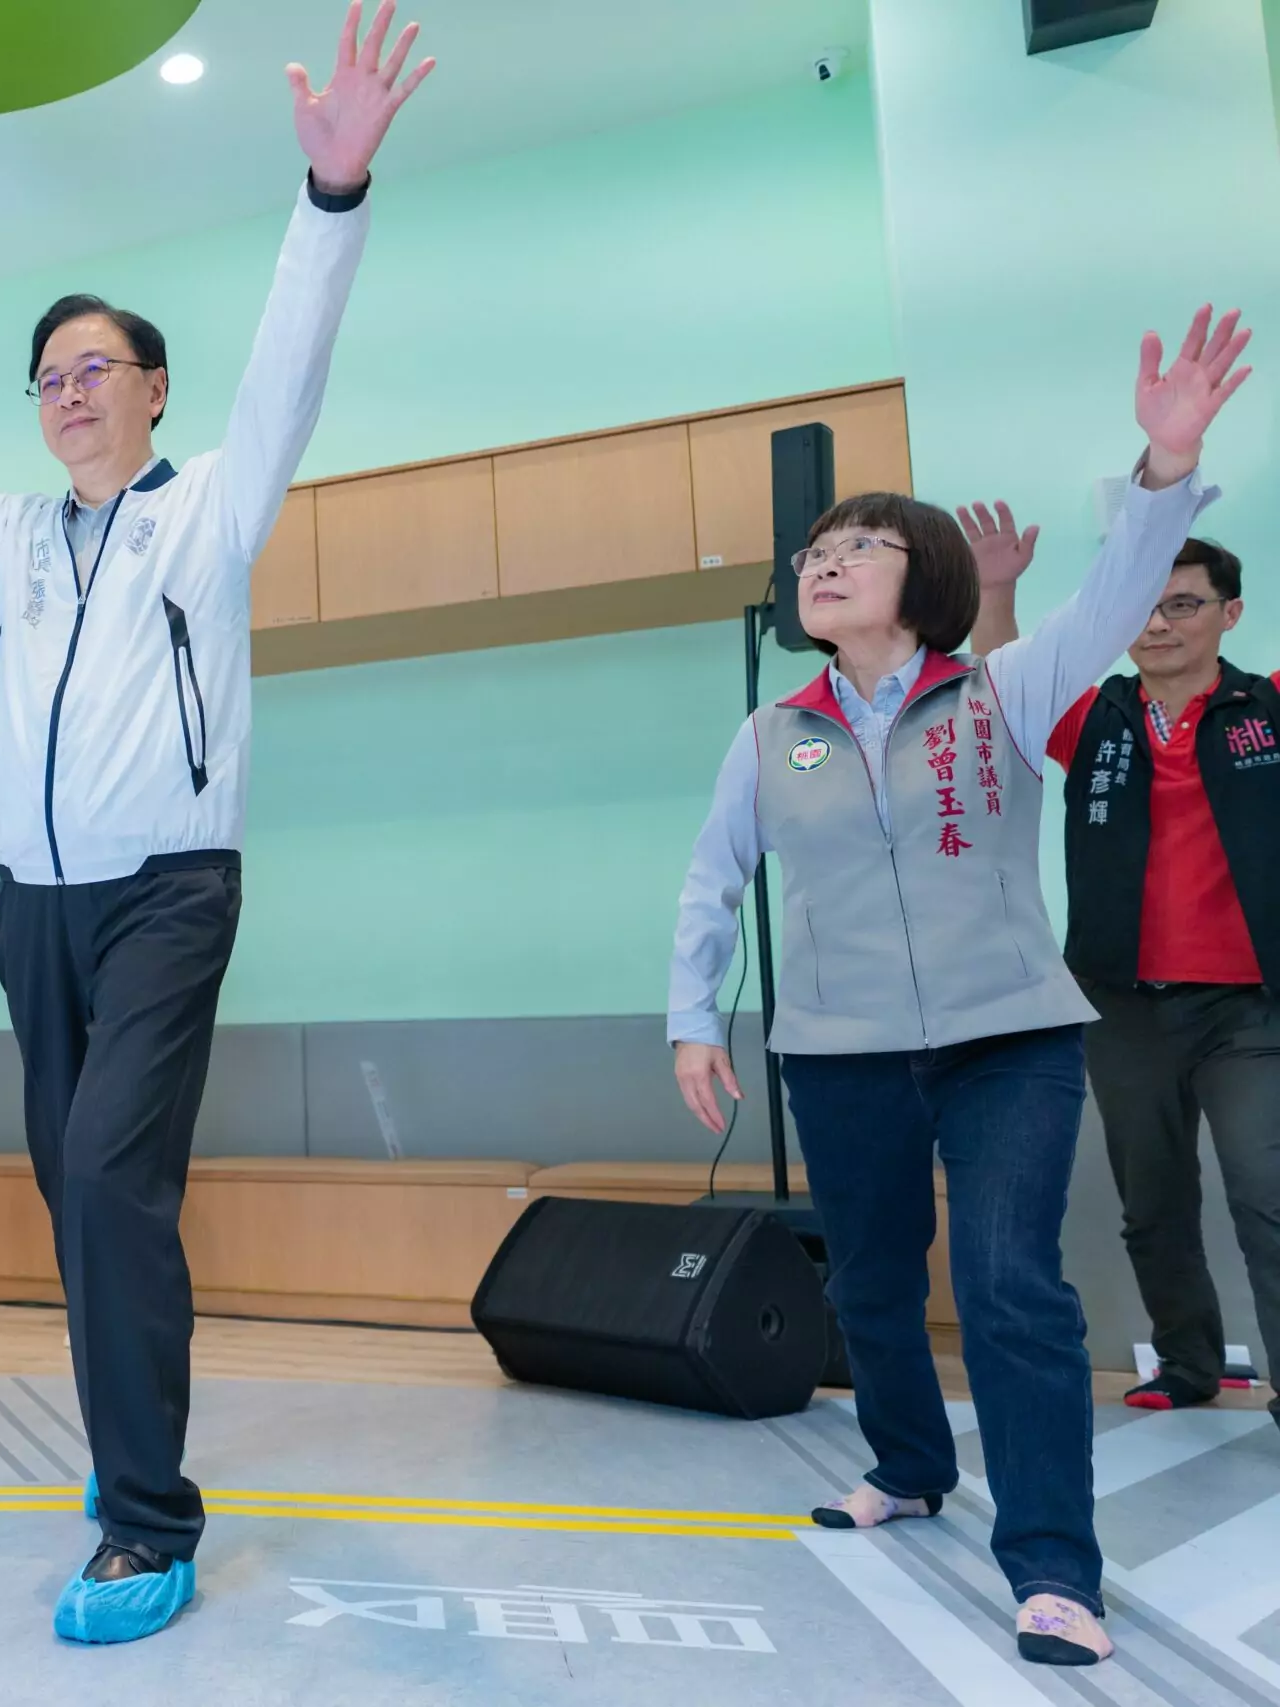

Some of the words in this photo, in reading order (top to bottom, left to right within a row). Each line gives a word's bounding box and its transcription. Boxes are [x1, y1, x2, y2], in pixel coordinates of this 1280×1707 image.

[923, 718, 972, 858] 劉曾玉春
[968, 697, 1002, 816] 桃園市議員
[1088, 739, 1116, 825] 許彥輝
